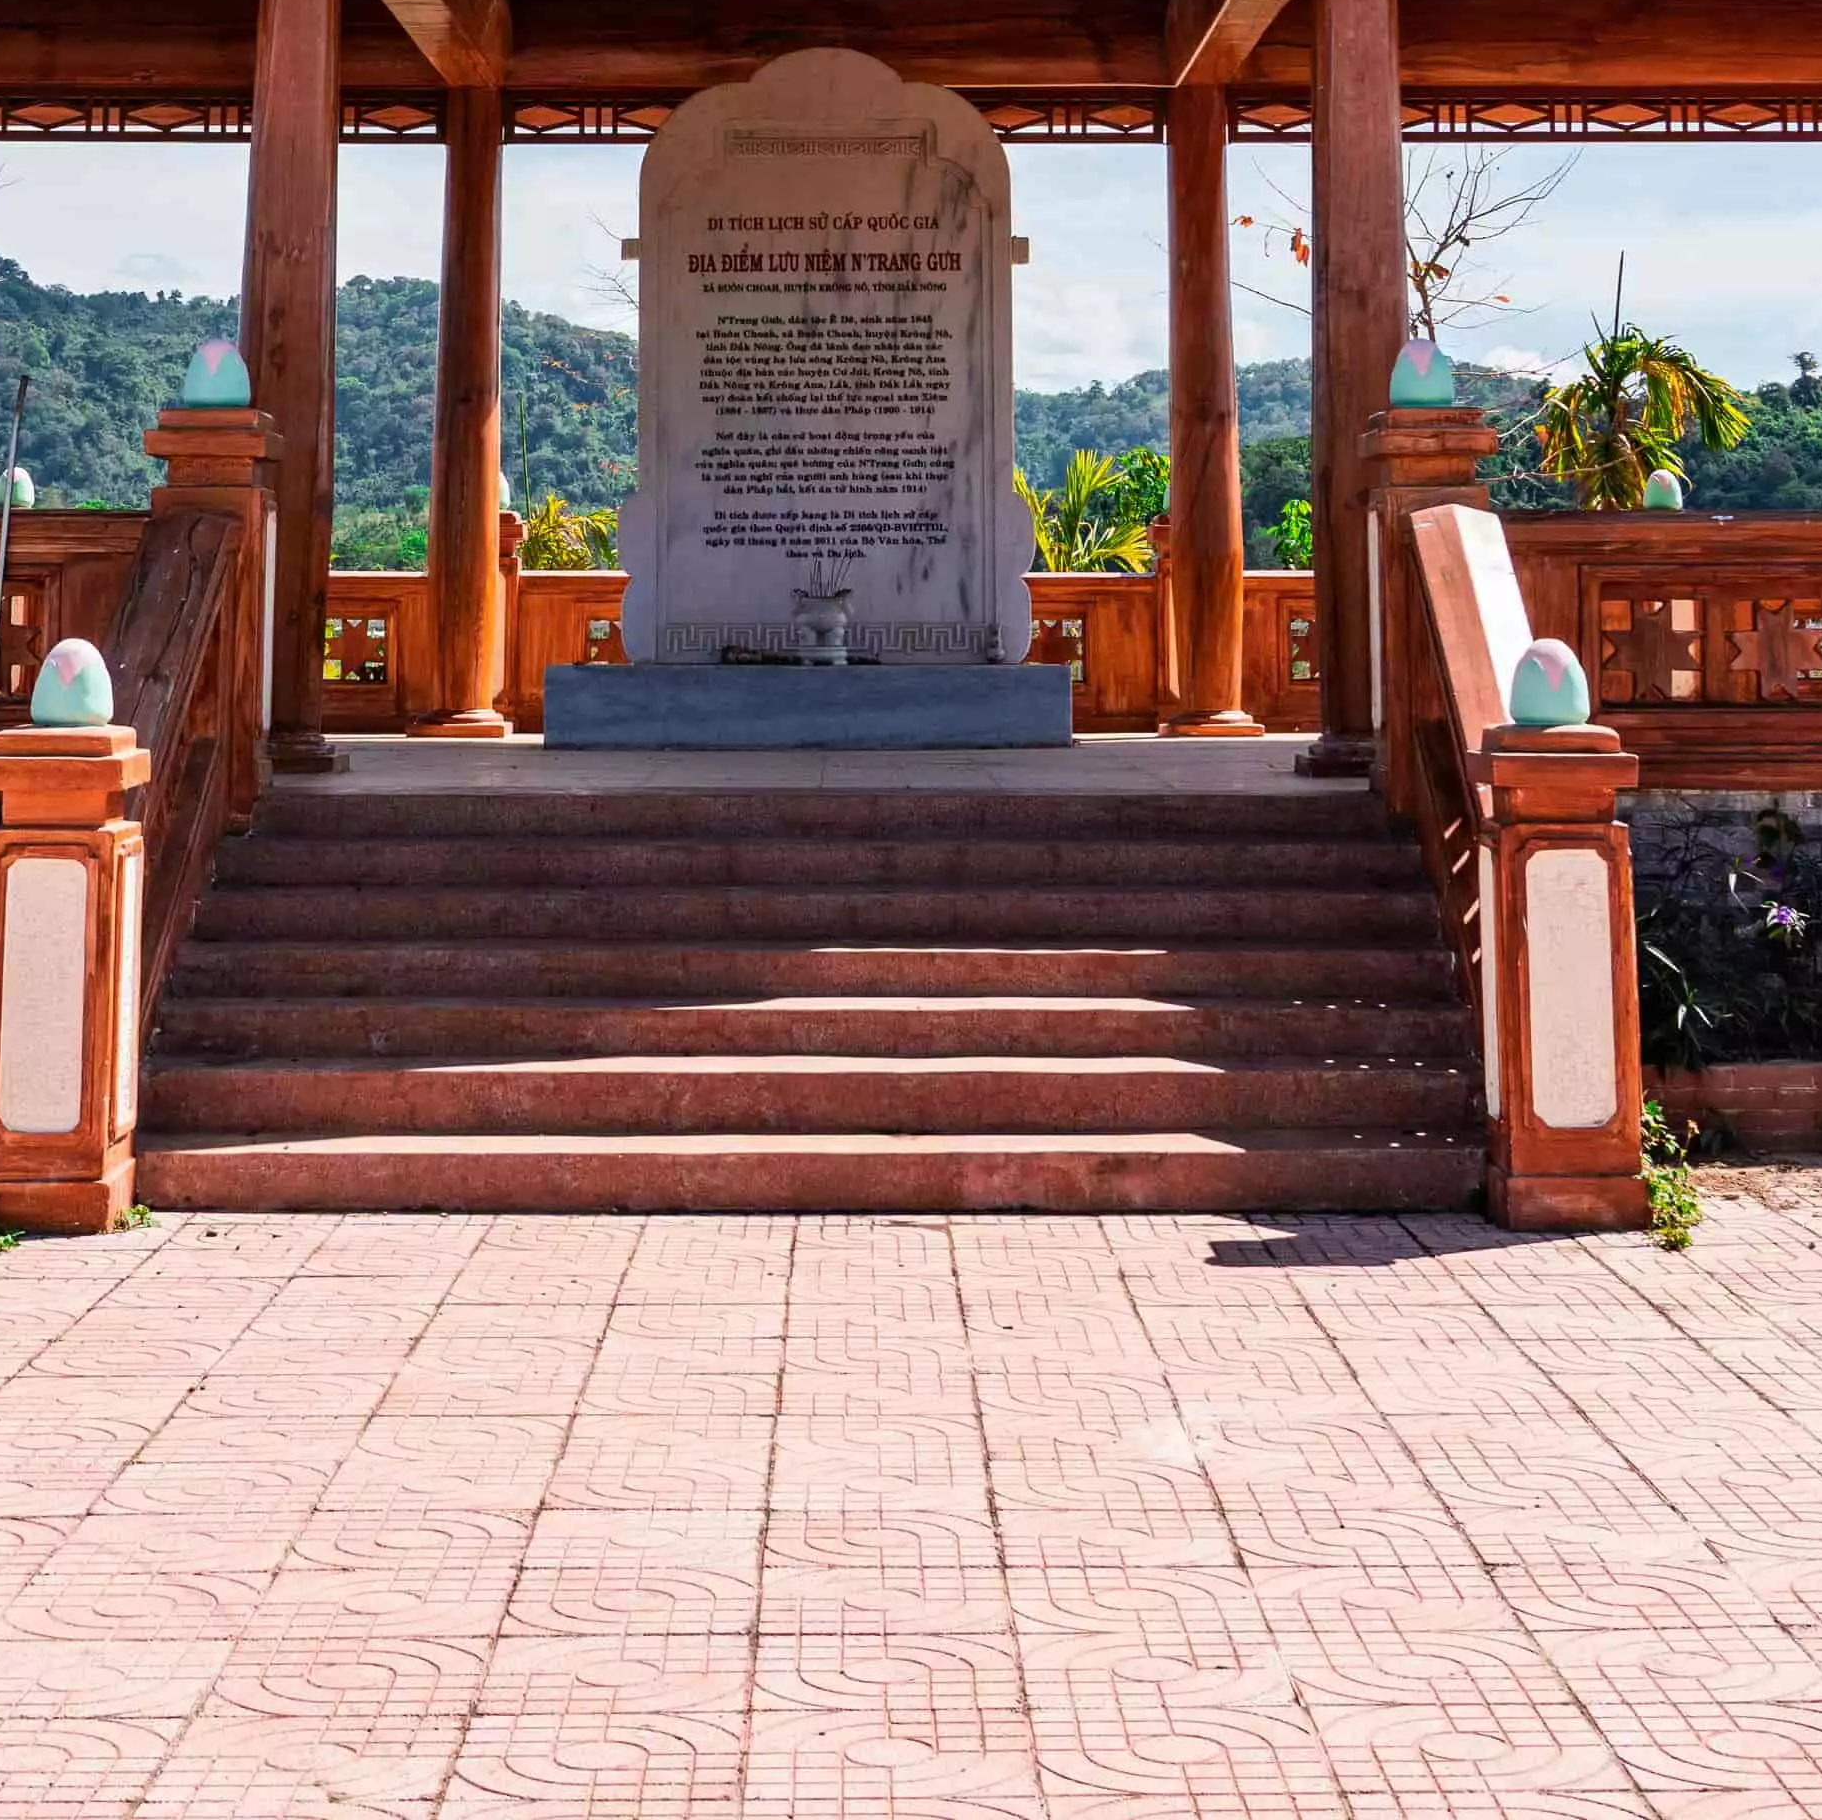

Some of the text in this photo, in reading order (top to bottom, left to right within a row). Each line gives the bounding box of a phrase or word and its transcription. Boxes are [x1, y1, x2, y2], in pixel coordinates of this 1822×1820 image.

[688, 243, 961, 277] ĐỊA ĐIỂM LƯU NIỆM N'TRANG GƯH
